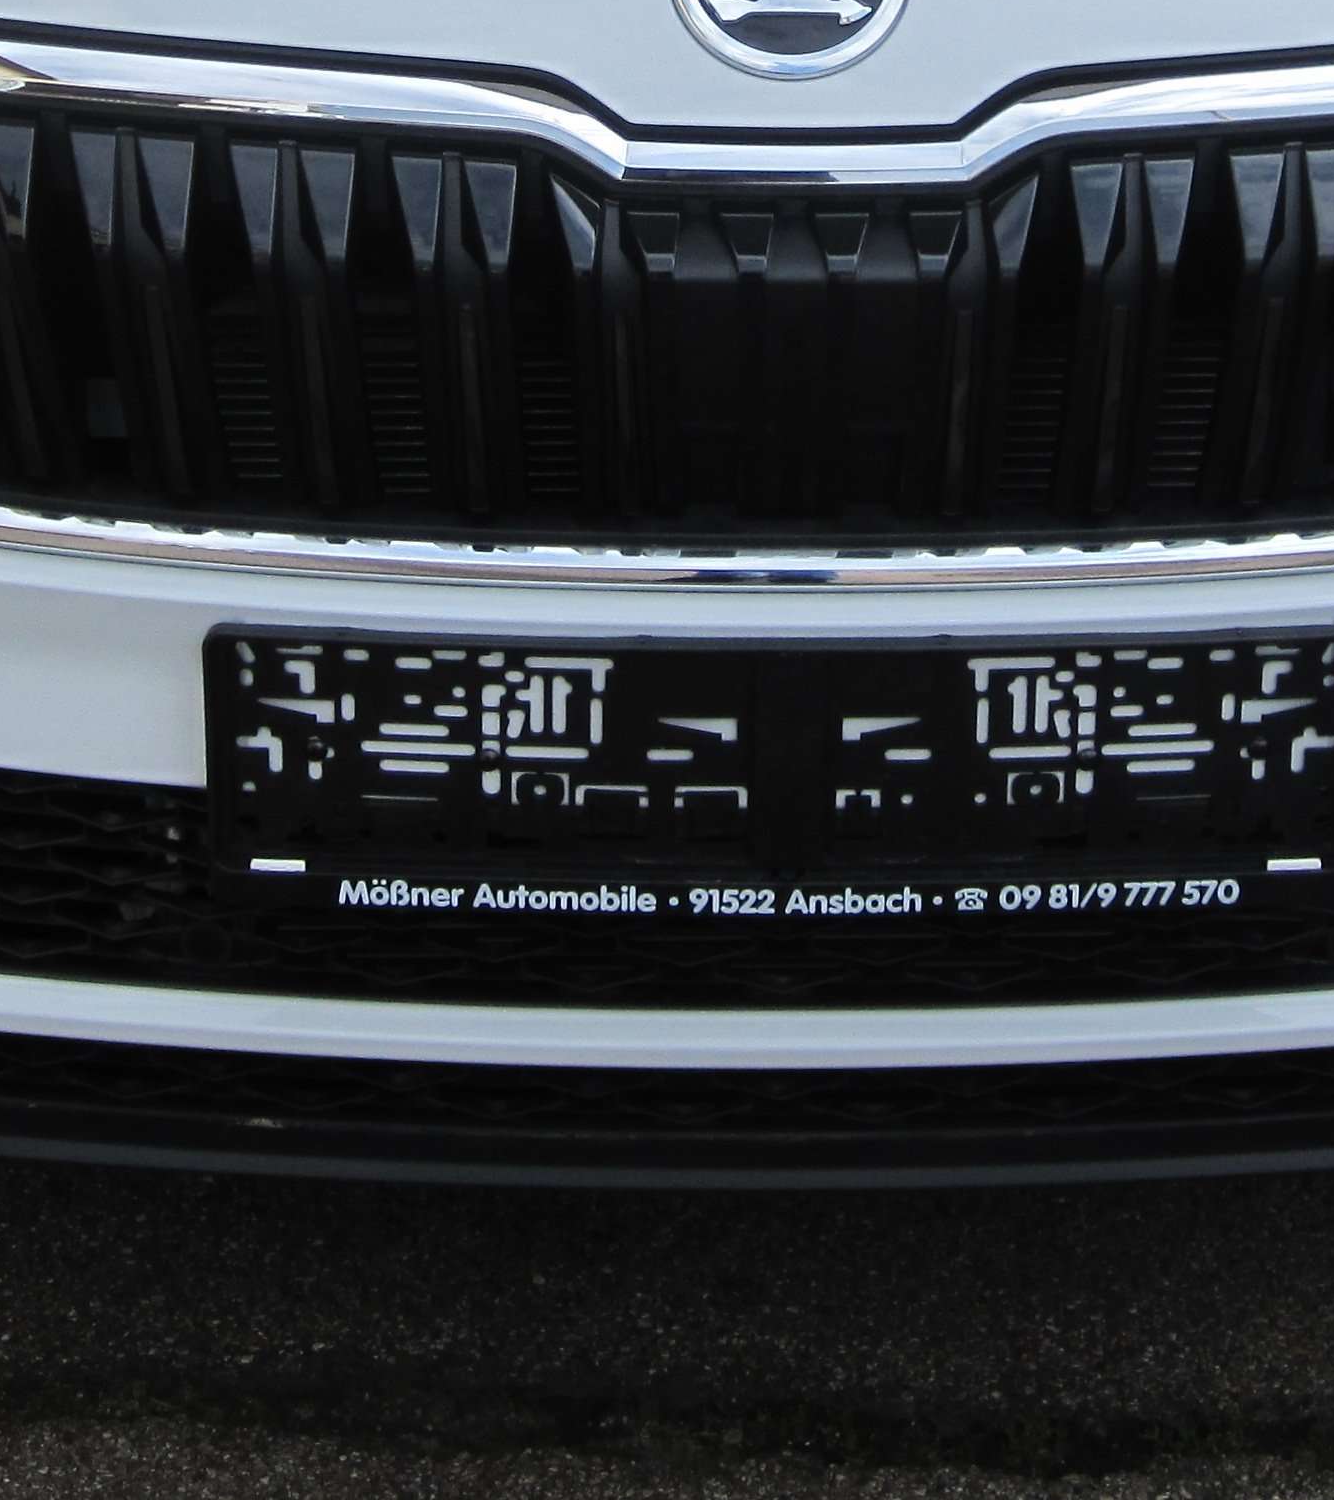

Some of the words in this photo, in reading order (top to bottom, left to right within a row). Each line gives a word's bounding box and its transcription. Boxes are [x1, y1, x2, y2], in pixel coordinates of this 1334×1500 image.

[338, 878, 465, 908] Mößner
[473, 883, 657, 913] Automobile
[689, 887, 776, 915] 91522
[784, 886, 922, 915] Ansbach
[999, 884, 1042, 910] 09
[1049, 881, 1117, 910] 81/9
[1123, 880, 1177, 907] 777
[1182, 878, 1241, 906] 570
